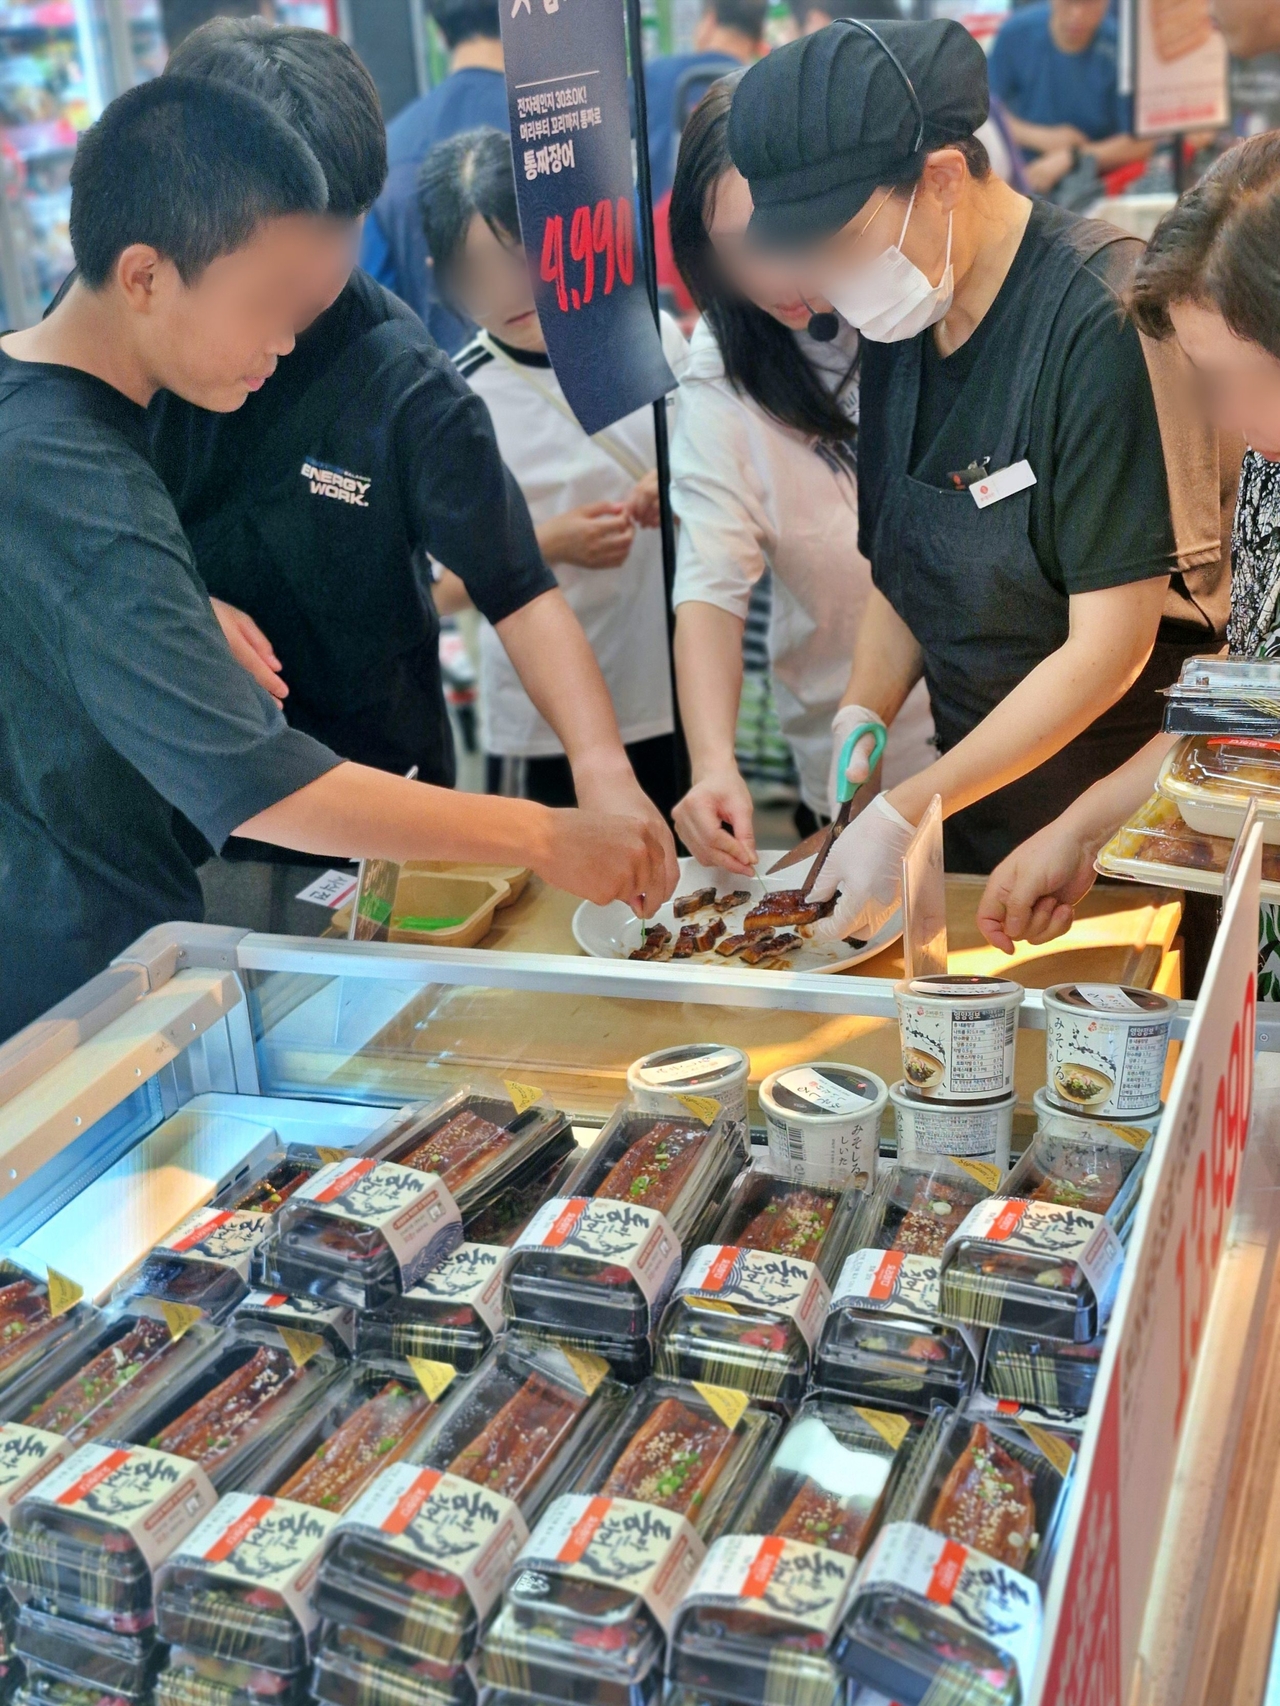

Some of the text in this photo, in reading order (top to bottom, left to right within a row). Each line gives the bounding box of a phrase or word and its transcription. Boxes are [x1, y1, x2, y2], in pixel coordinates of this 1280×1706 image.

[517, 86, 587, 118] 전자레인지 30초OK!
[520, 107, 602, 142] 머리부터 꼬리까지 통짜로
[523, 139, 575, 181] 통짜장어
[540, 196, 634, 313] 4,990
[301, 463, 371, 494] ENERGY
[1054, 1017, 1065, 1081] みそしる
[851, 1124, 863, 1175] みそしる
